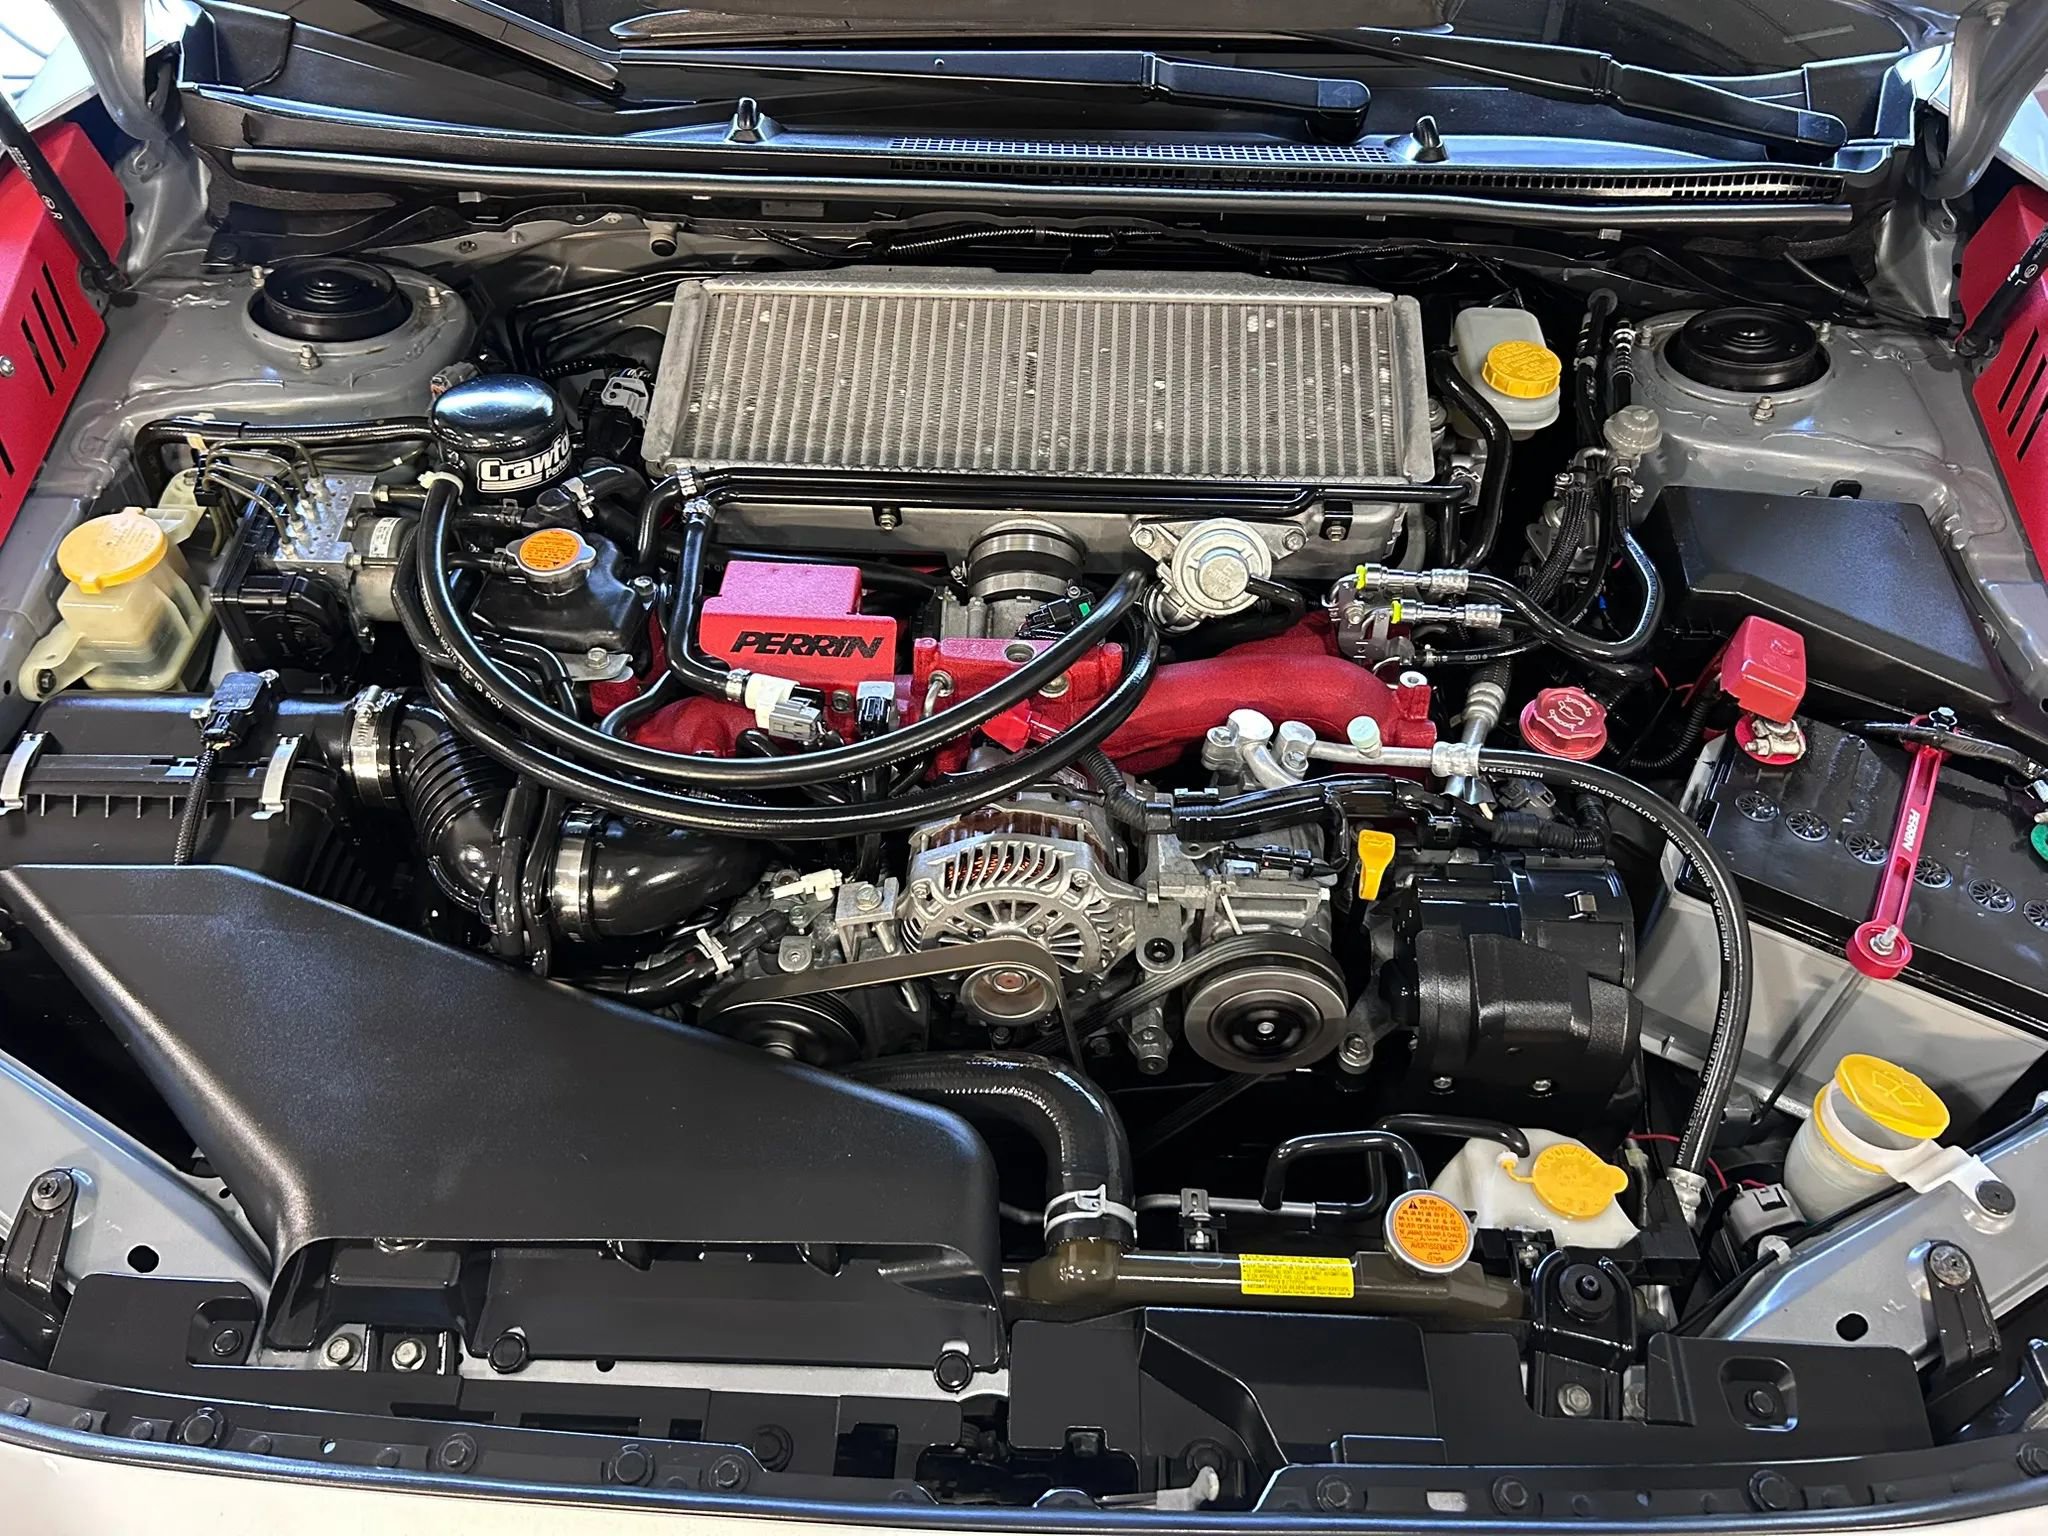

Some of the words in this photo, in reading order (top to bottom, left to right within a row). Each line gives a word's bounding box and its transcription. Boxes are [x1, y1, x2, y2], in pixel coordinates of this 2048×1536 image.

[730, 631, 885, 659] PERRIN
[485, 692, 504, 710] PCV
[1902, 807, 1921, 853] PERRIN
